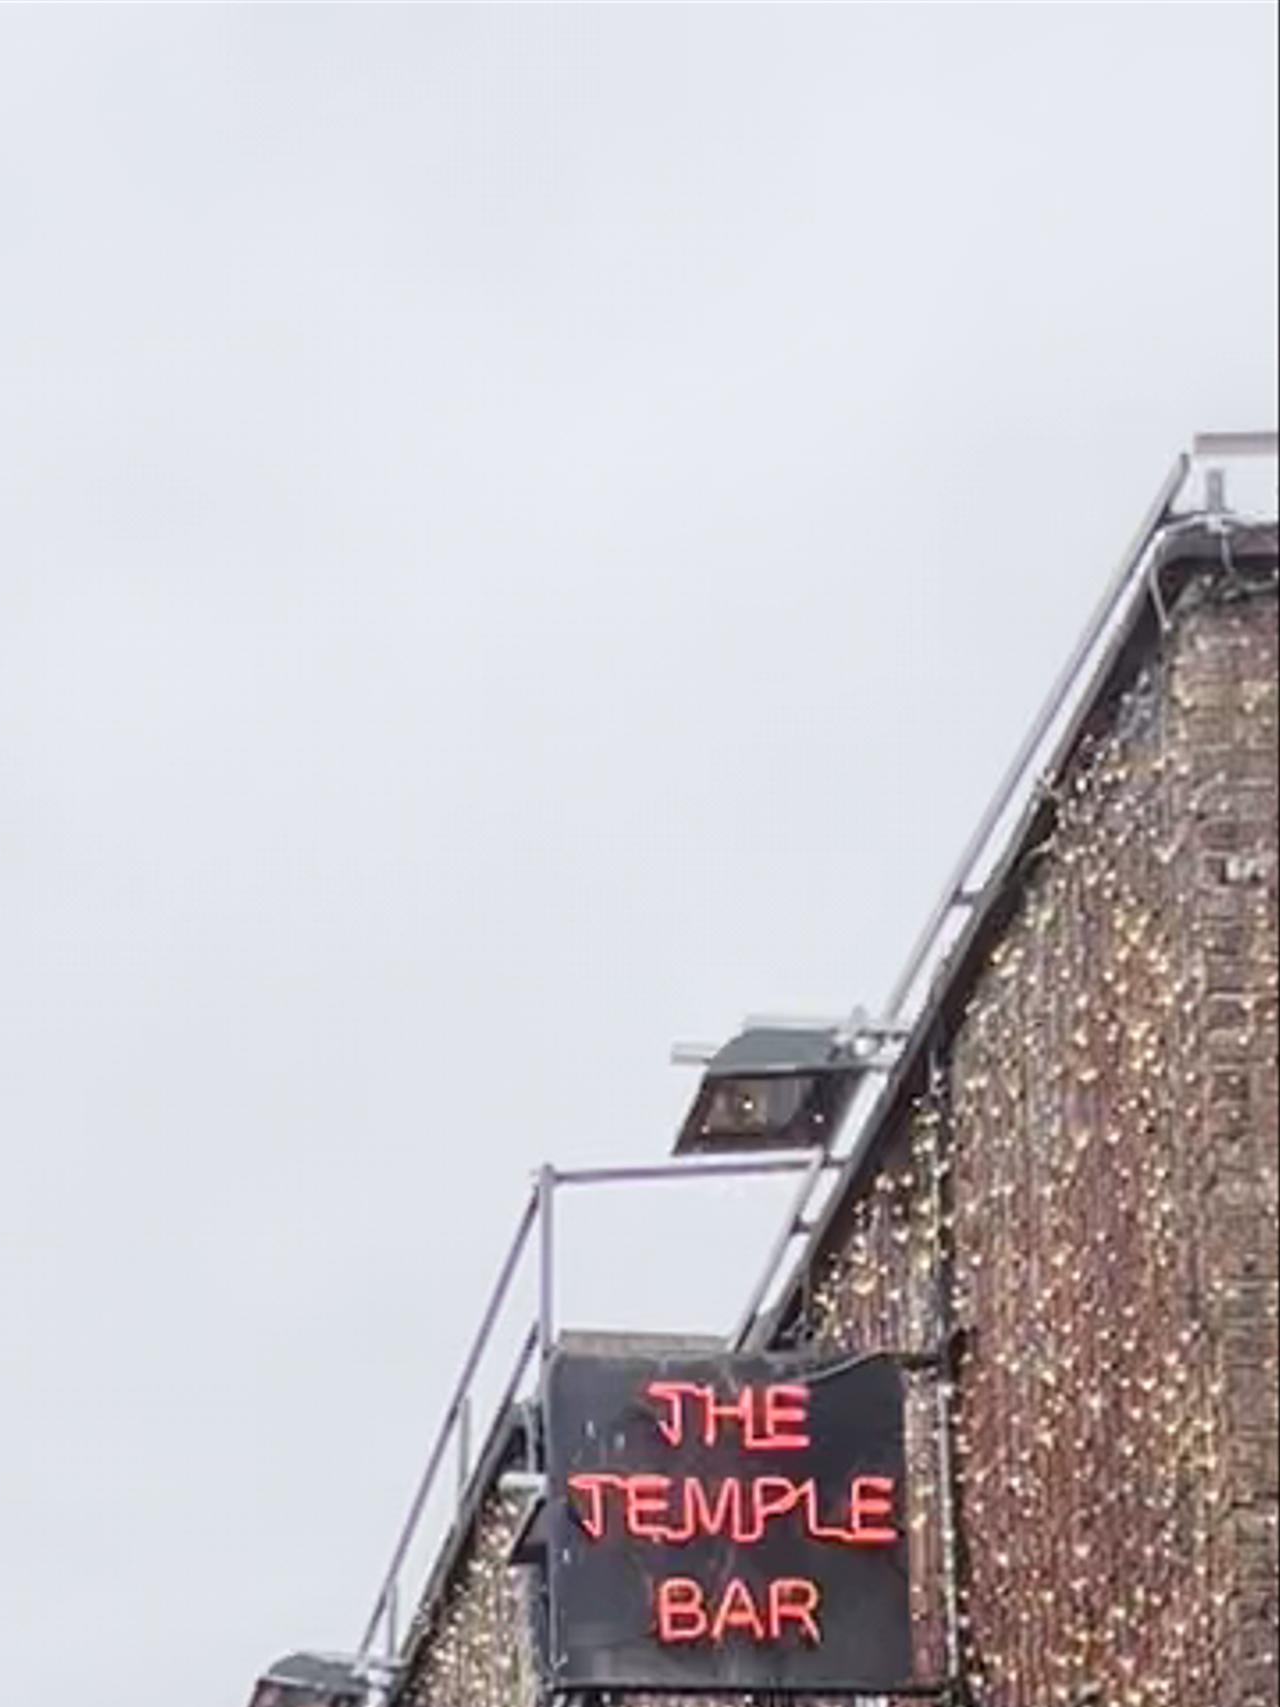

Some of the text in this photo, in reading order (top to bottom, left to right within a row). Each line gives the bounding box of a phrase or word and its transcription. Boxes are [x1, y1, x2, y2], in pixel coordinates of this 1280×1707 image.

[647, 1380, 811, 1449] THE
[568, 1473, 897, 1542] TEMPLE
[659, 1577, 822, 1643] BAR
